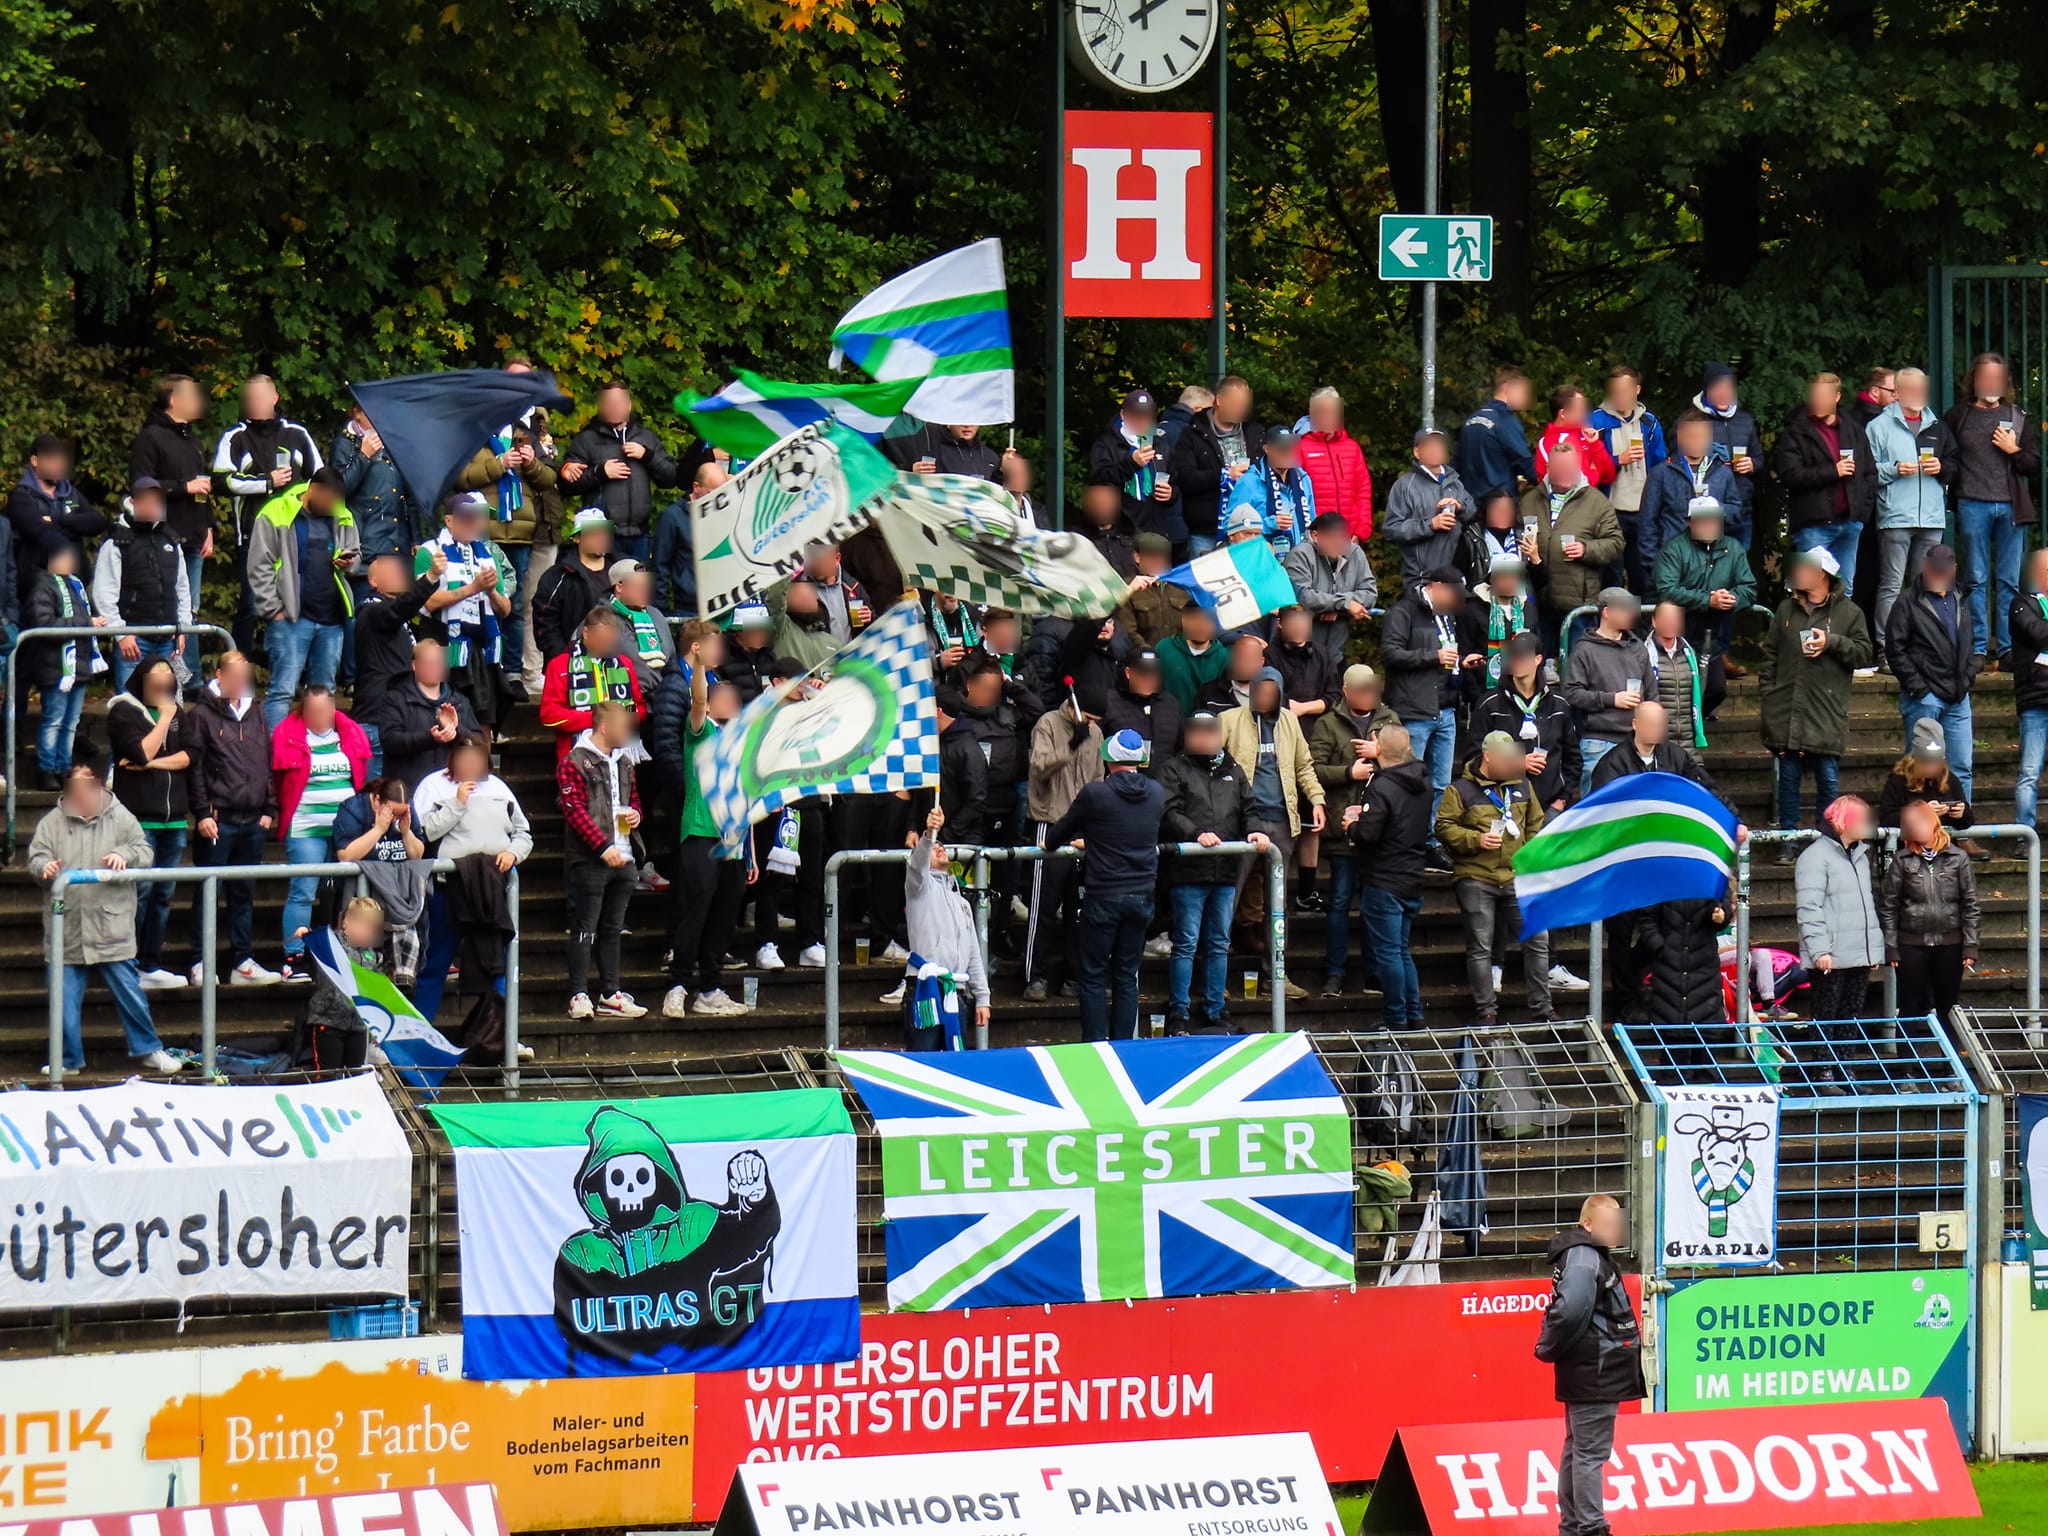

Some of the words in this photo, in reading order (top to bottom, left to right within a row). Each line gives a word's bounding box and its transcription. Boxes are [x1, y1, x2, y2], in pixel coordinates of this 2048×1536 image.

[1072, 148, 1200, 279] H
[699, 492, 729, 518] FC
[708, 574, 758, 613] DIE
[44, 1101, 290, 1166] Aktive
[919, 1121, 1319, 1191] LEICESTER
[0, 1185, 408, 1283] ütersloher
[1933, 1223, 1951, 1250] 5
[571, 1289, 700, 1334] ULTRAS
[712, 1283, 762, 1326] GT
[1461, 1293, 1553, 1315] HAGEDO
[1697, 1300, 1875, 1332] OHLENDORF
[1695, 1333, 1826, 1363] STADION
[1696, 1373, 1731, 1399] IM
[1743, 1367, 1910, 1395] HEIDEWALD
[552, 1415, 607, 1431] Maler-
[612, 1411, 644, 1429] und
[745, 1372, 1214, 1441] WERTSTOFFZENTRUM
[360, 1404, 470, 1458] Farbe
[506, 1431, 689, 1457] Bodenbelagsarbeiten
[533, 1460, 569, 1475] vom
[574, 1456, 661, 1473] Fachmann
[1436, 1428, 1940, 1519] HAGEDORN
[785, 1491, 1022, 1533] PANNHORST
[1068, 1475, 1298, 1515] PANNHORST
[1188, 1516, 1308, 1536] ENTSORGUNG
